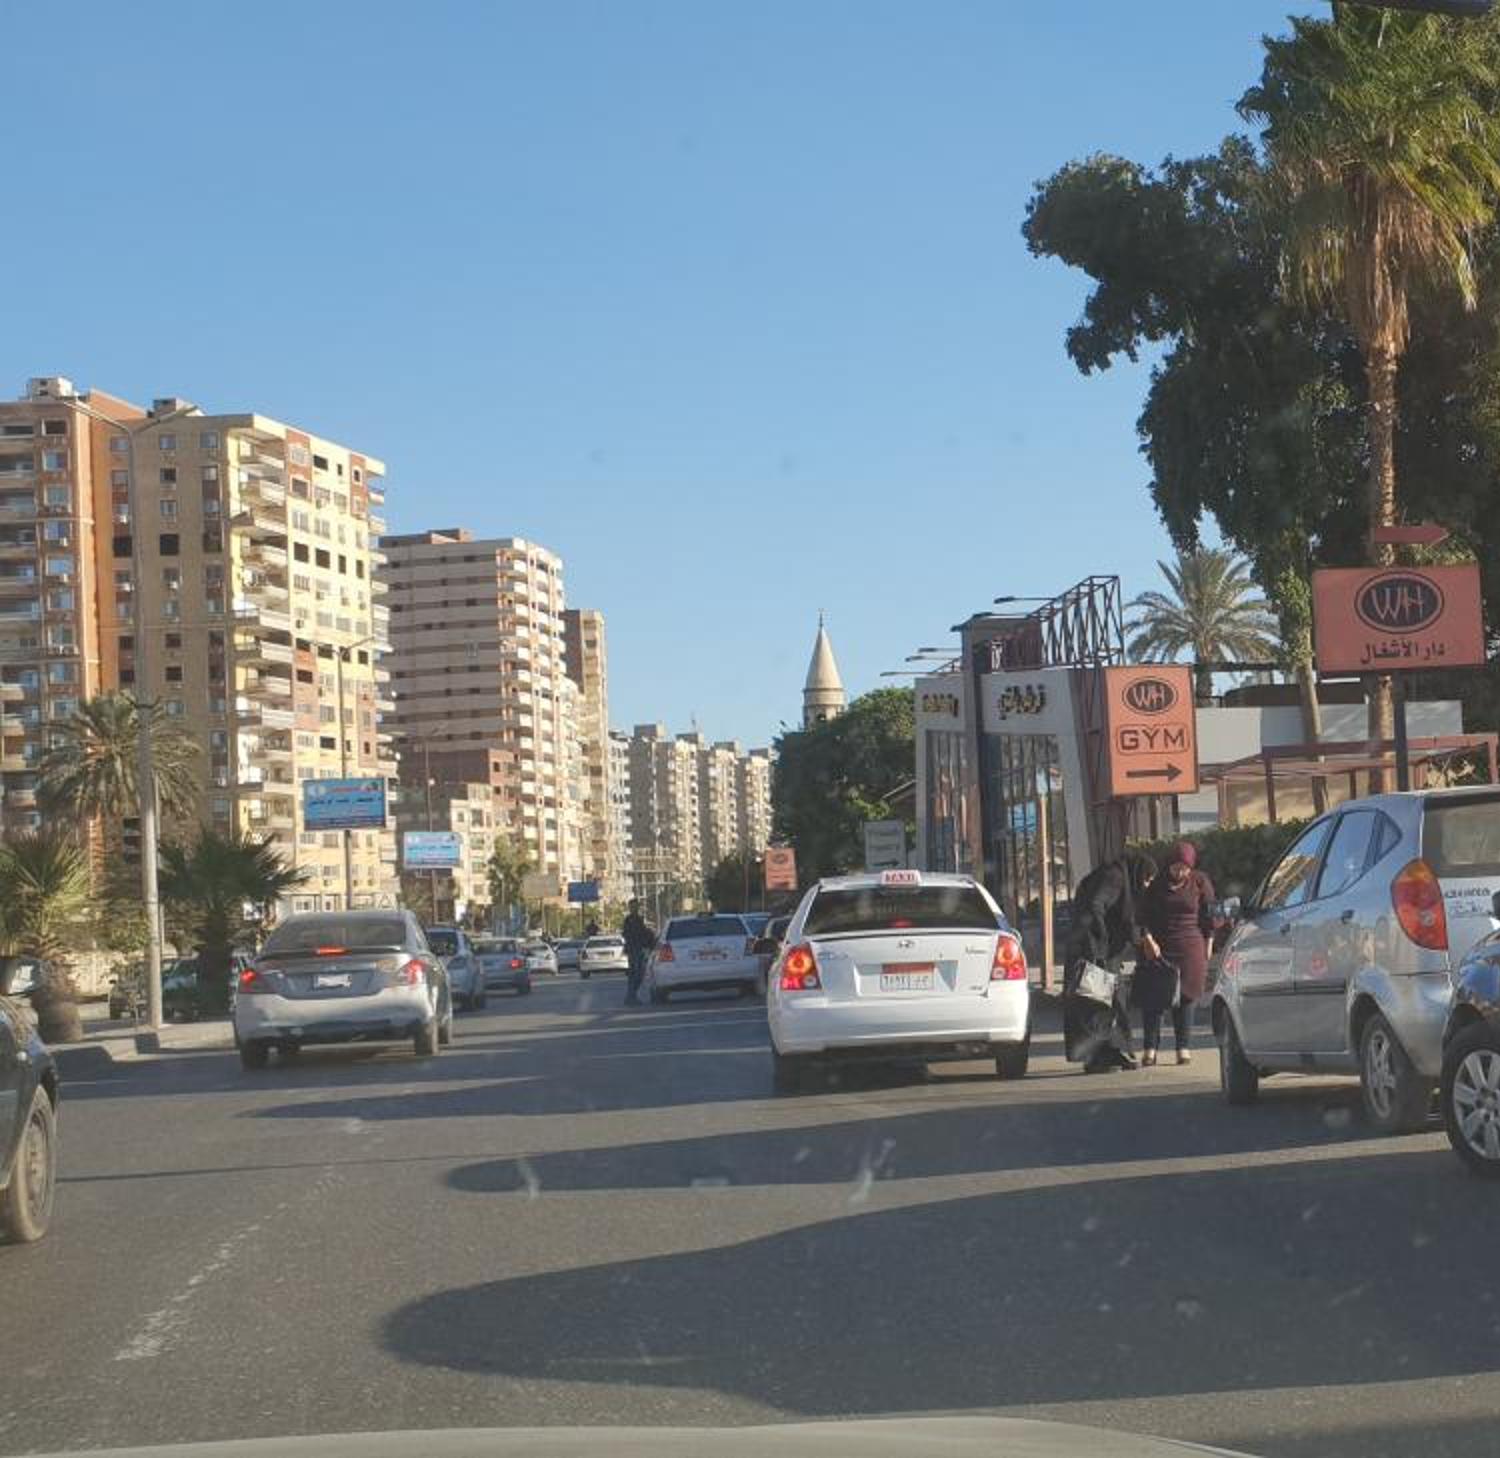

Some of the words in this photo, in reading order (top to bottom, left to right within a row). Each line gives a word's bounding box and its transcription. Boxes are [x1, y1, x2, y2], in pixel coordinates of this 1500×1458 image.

[1369, 585, 1424, 621] WH
[1424, 640, 1446, 660] دار
[1132, 685, 1166, 709] WH
[1120, 727, 1185, 751] GYM
